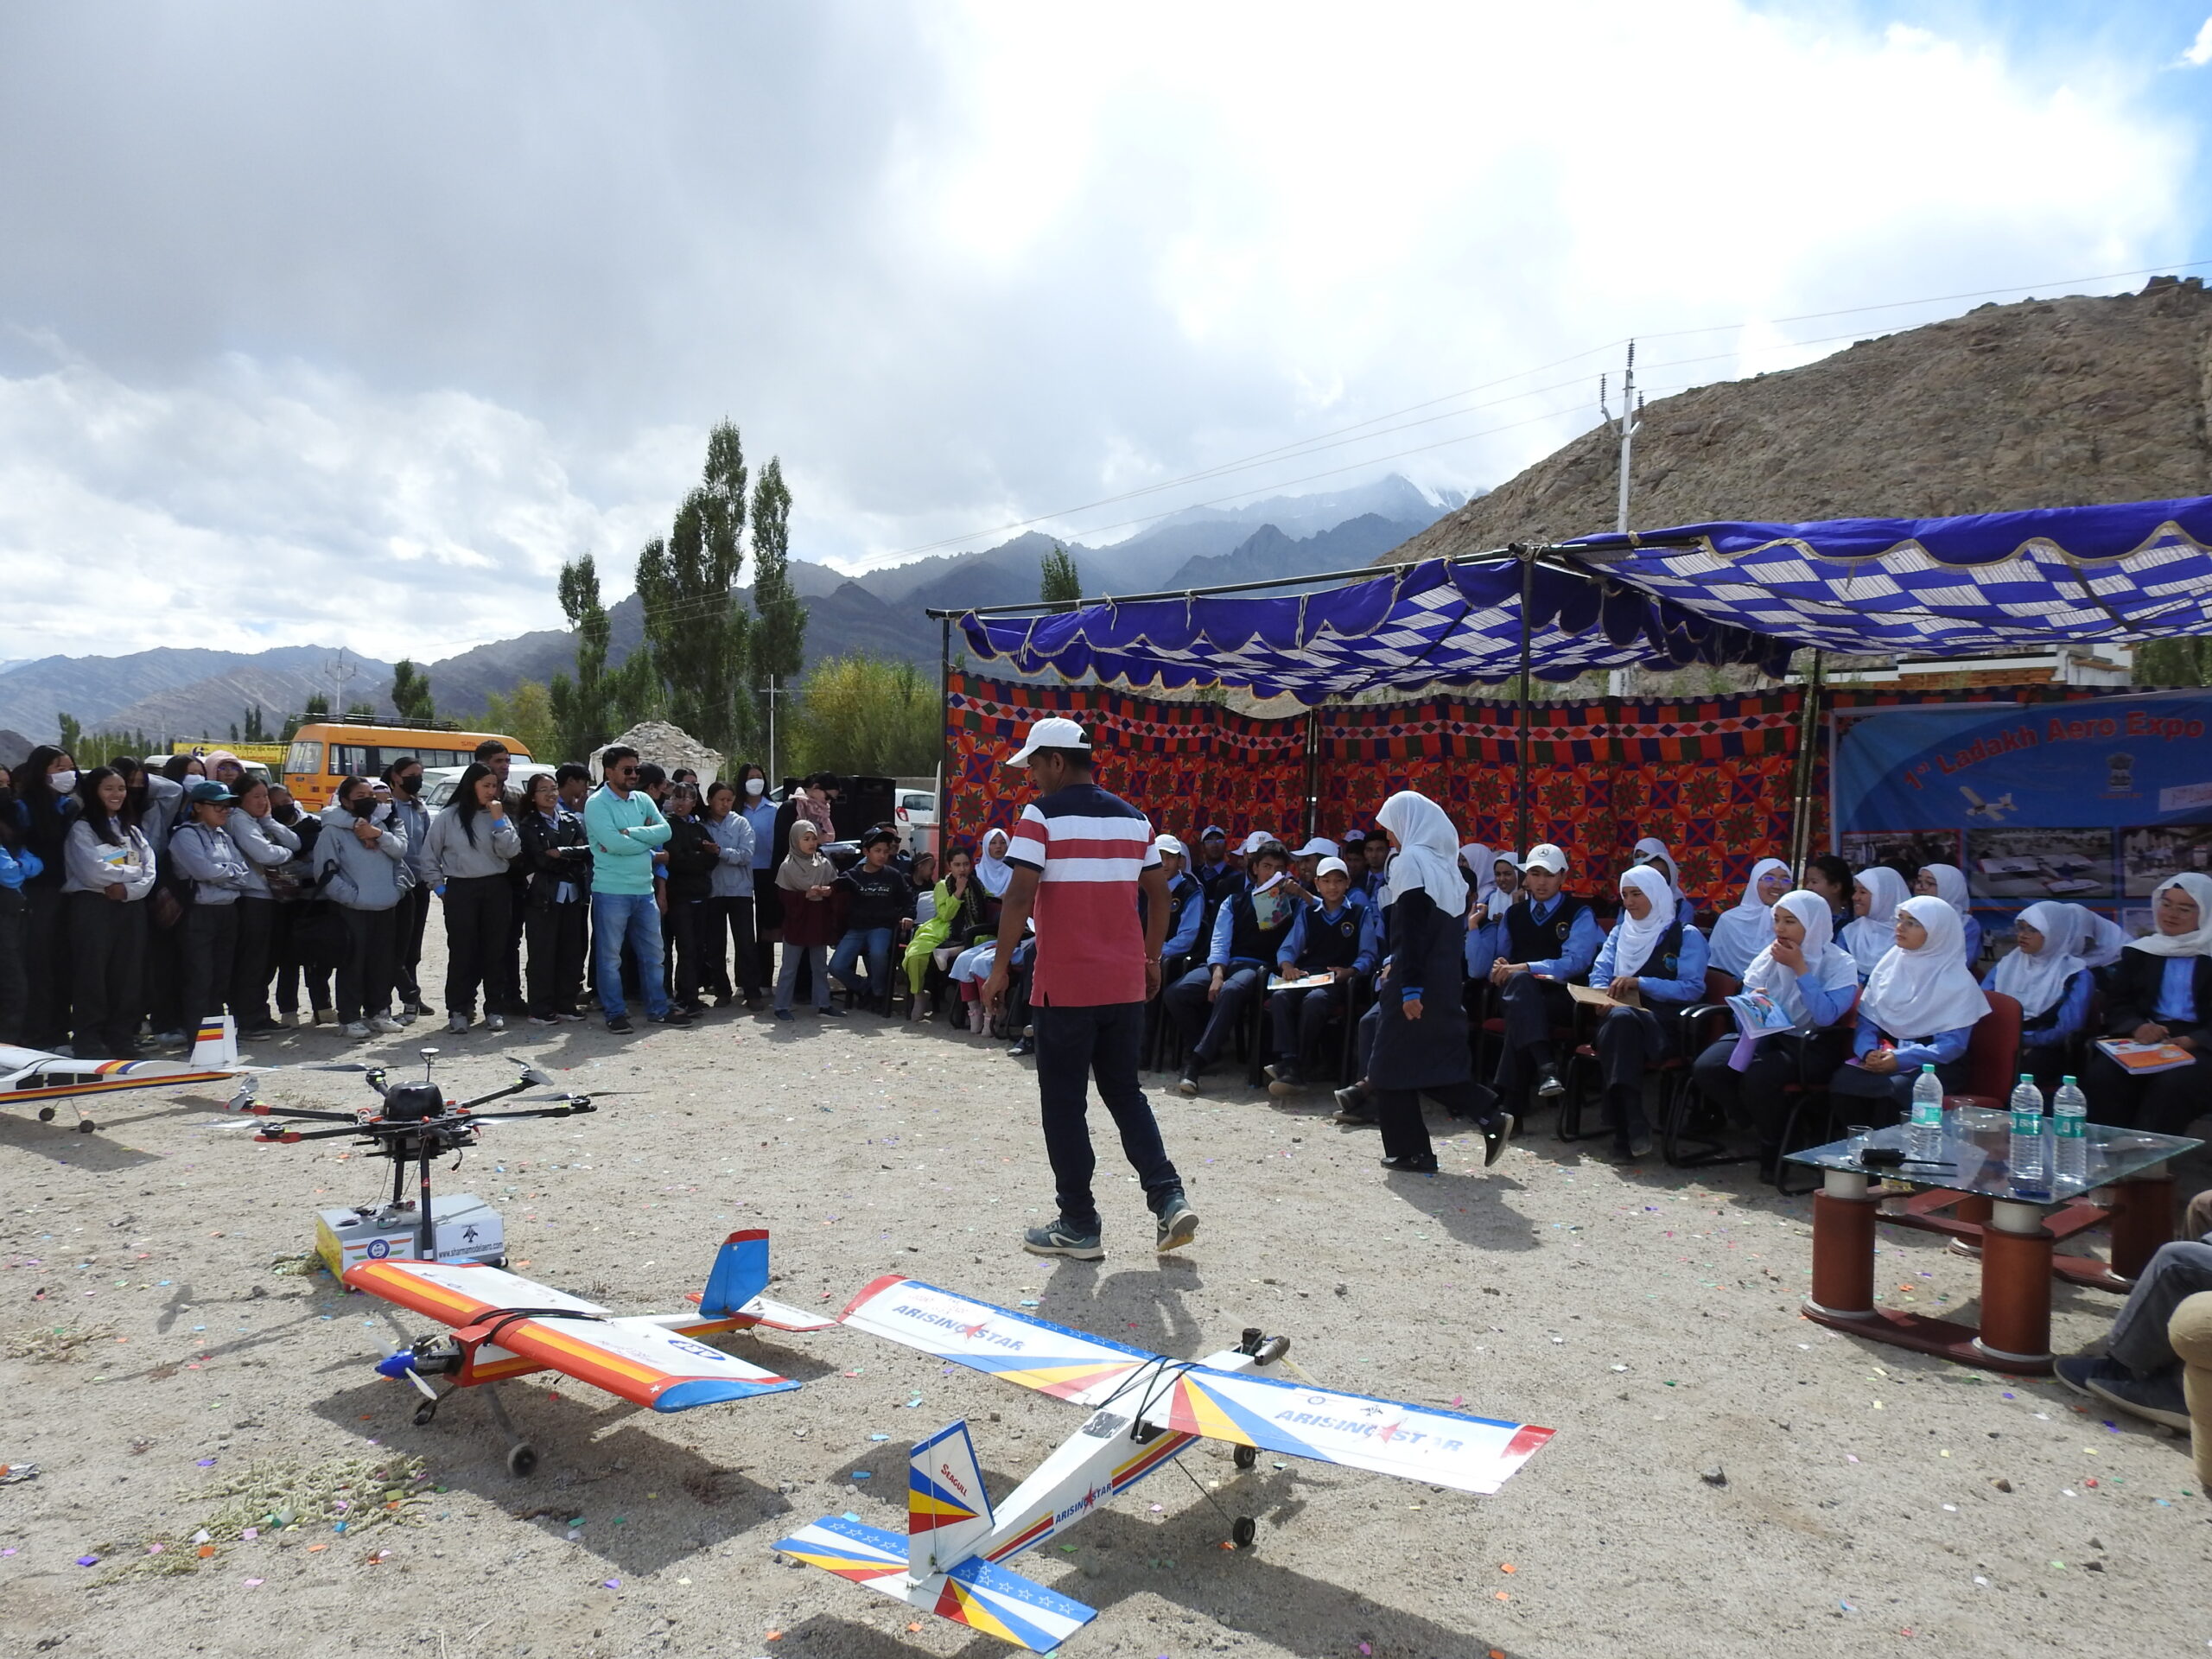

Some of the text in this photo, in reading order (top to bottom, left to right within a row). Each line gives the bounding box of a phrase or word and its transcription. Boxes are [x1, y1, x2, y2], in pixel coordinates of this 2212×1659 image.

[1904, 710, 2205, 790] 1st Ladakh Aero Expo
[974, 1328, 1026, 1351] STAR
[1091, 1482, 1112, 1502] STAR
